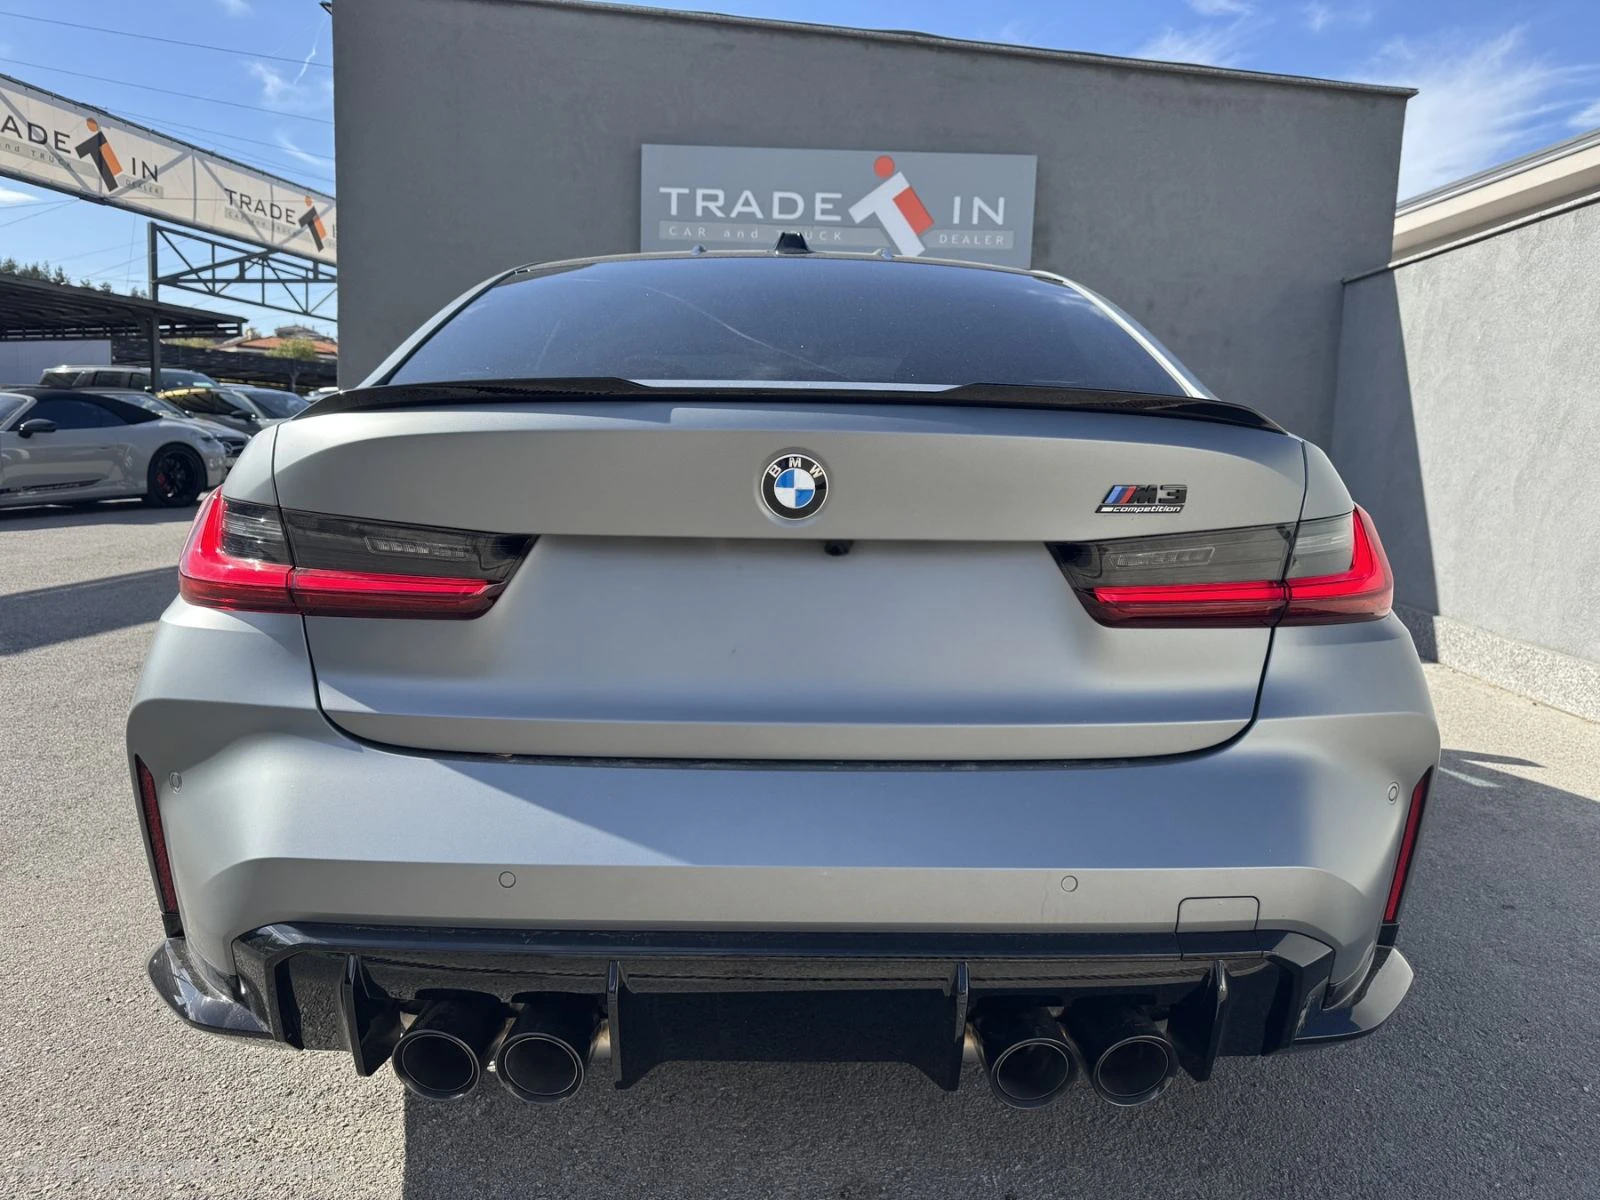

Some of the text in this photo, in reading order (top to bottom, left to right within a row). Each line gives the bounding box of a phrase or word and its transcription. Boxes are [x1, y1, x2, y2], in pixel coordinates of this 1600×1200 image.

[131, 157, 158, 182] IN
[224, 188, 297, 226] TRADE
[659, 187, 1005, 225] TRADE IN
[668, 226, 707, 237] CAR
[723, 229, 759, 239] and
[939, 234, 1005, 245] DEALER
[768, 457, 823, 479] BMW
[1122, 484, 1188, 504] M3
[1112, 505, 1182, 513] competition
